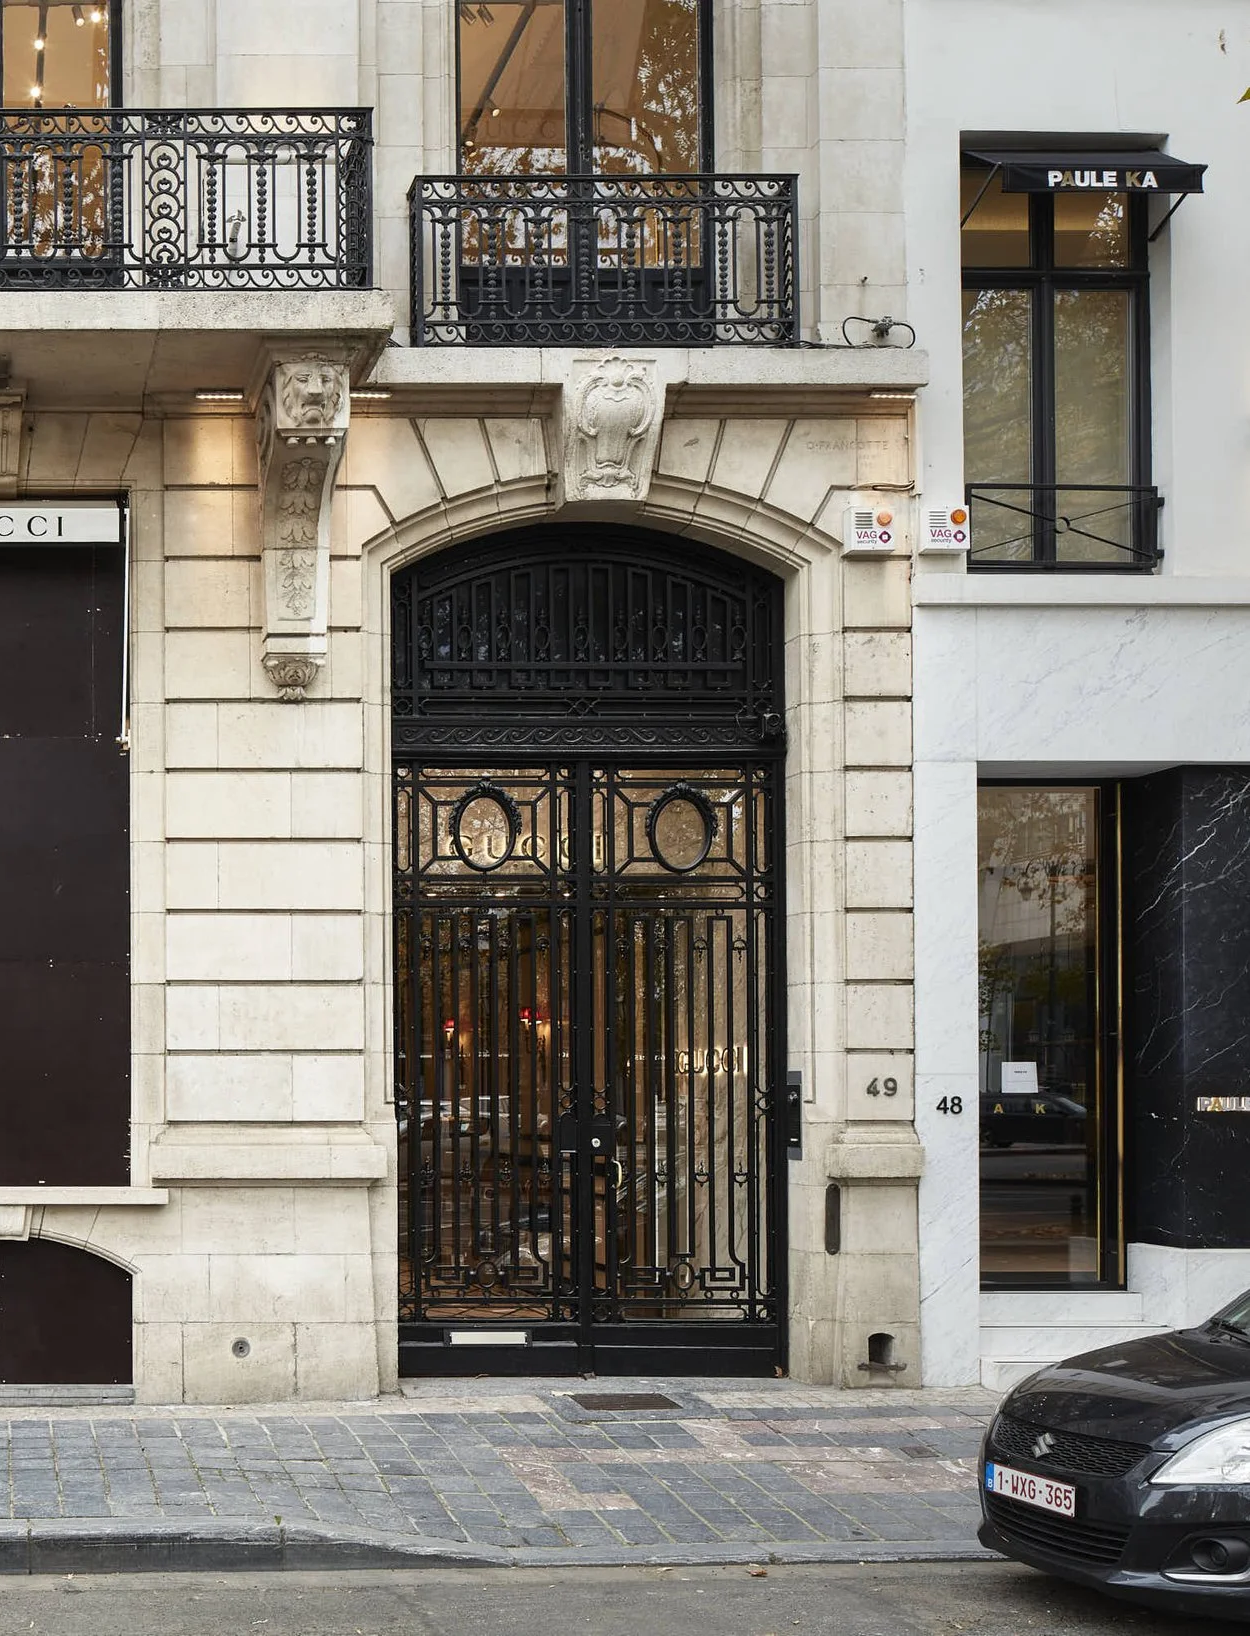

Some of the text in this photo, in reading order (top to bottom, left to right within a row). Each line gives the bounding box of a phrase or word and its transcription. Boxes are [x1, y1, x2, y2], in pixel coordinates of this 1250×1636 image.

[1047, 170, 1158, 188] PAULE KA
[856, 530, 877, 539] VAG
[930, 529, 952, 538] VAG
[866, 1077, 898, 1097] 49
[936, 1095, 963, 1115] 48
[987, 1478, 993, 1488] B
